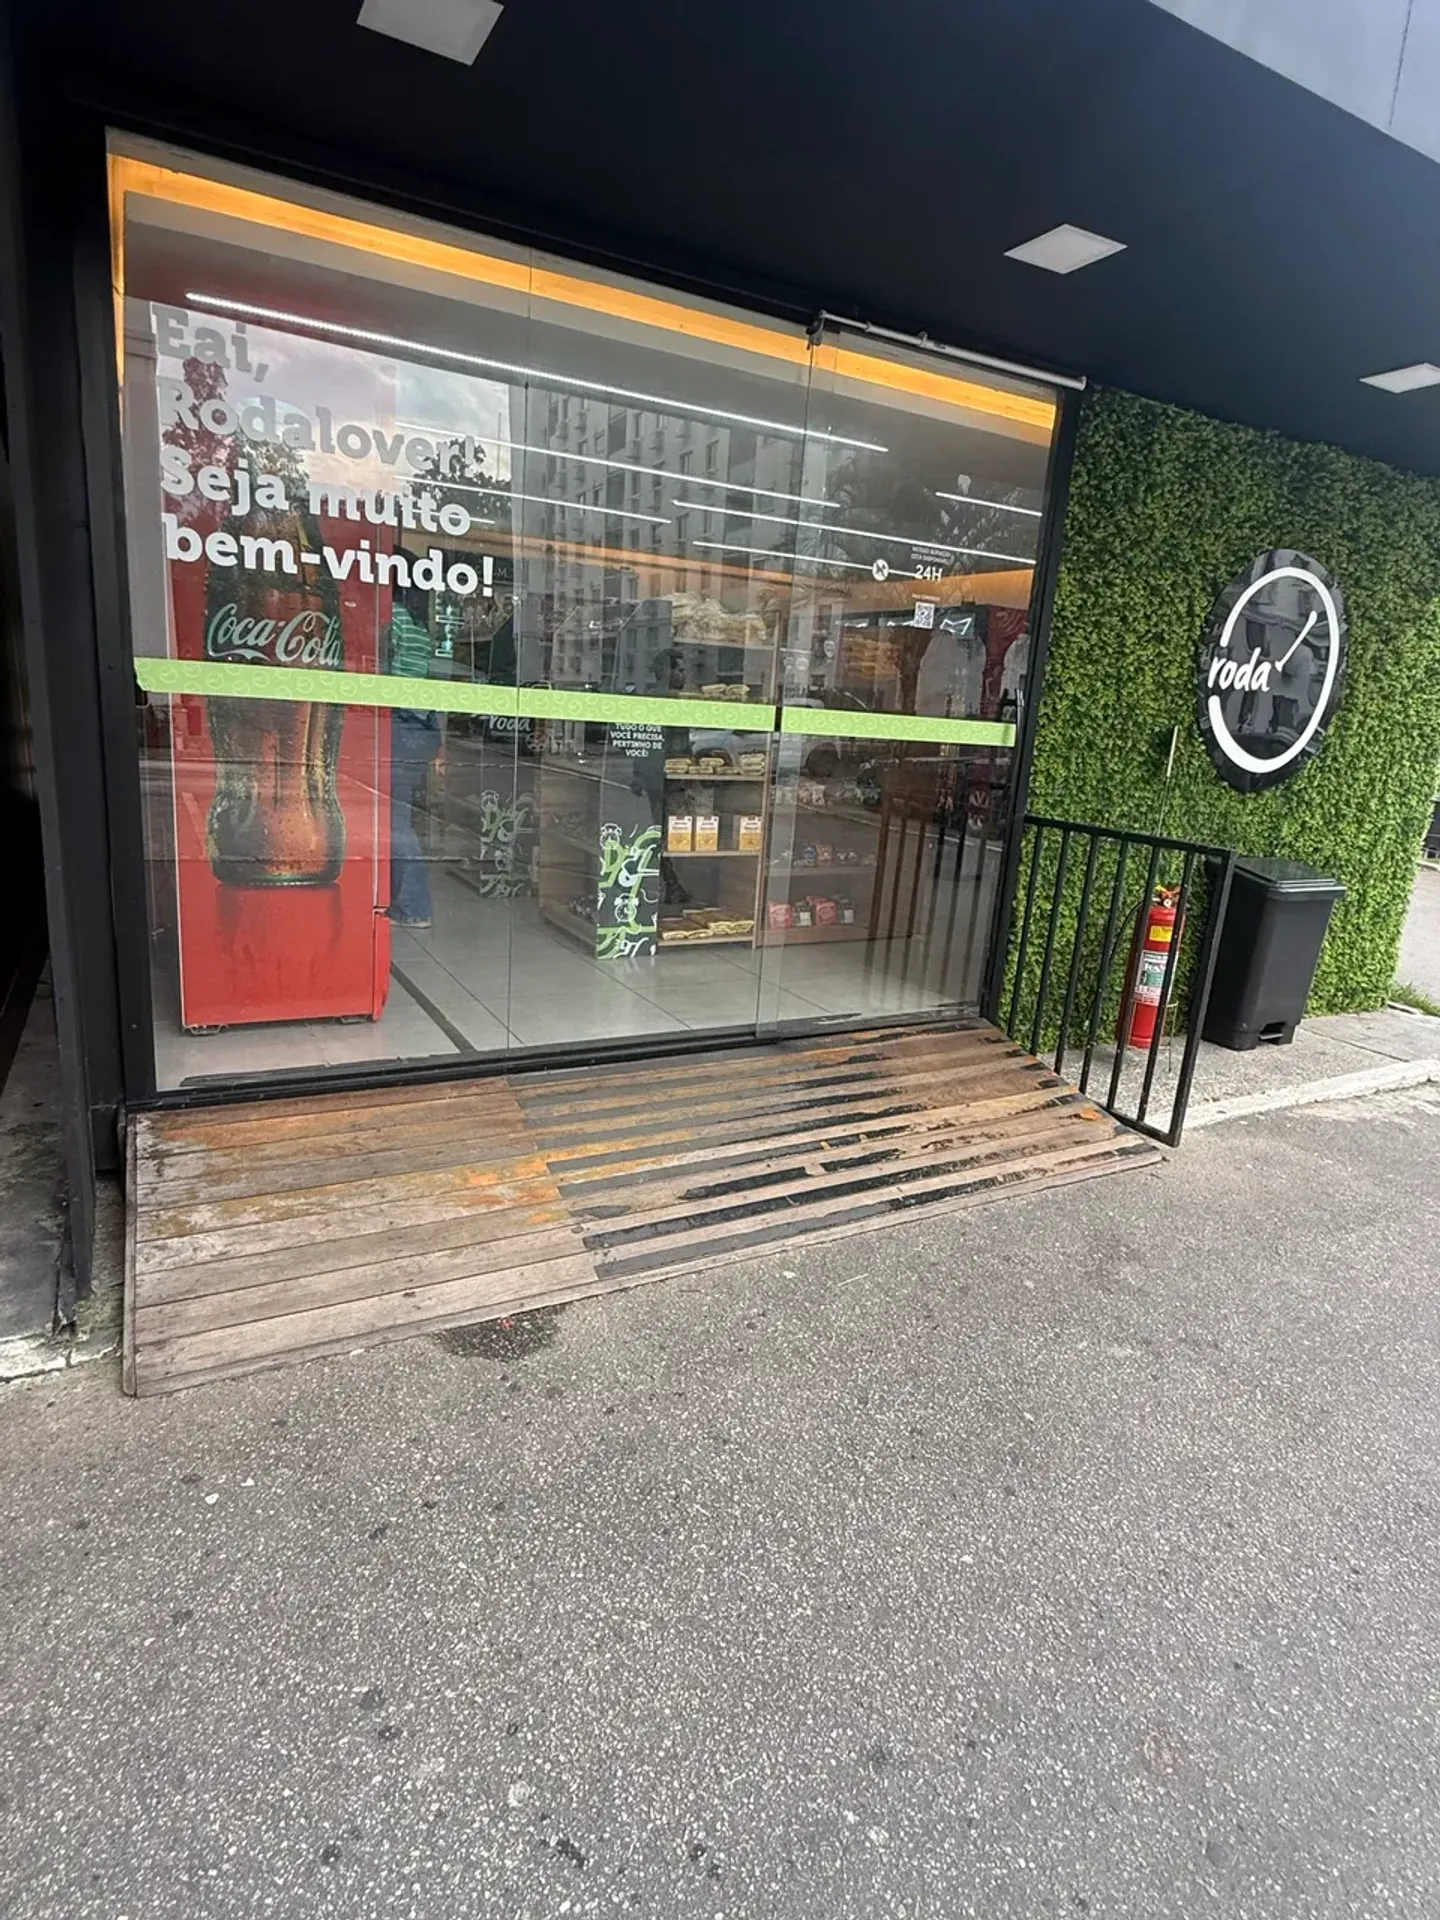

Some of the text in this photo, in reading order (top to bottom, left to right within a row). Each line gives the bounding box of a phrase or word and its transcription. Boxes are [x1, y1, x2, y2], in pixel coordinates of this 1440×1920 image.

[152, 303, 269, 383] Eai,
[157, 375, 477, 478] Rodalover!
[160, 445, 472, 536] Seja muito
[162, 512, 494, 598] bem-vindo!
[915, 564, 943, 582] 24H
[207, 602, 341, 666] Coca-Cola
[1207, 646, 1272, 693] roda
